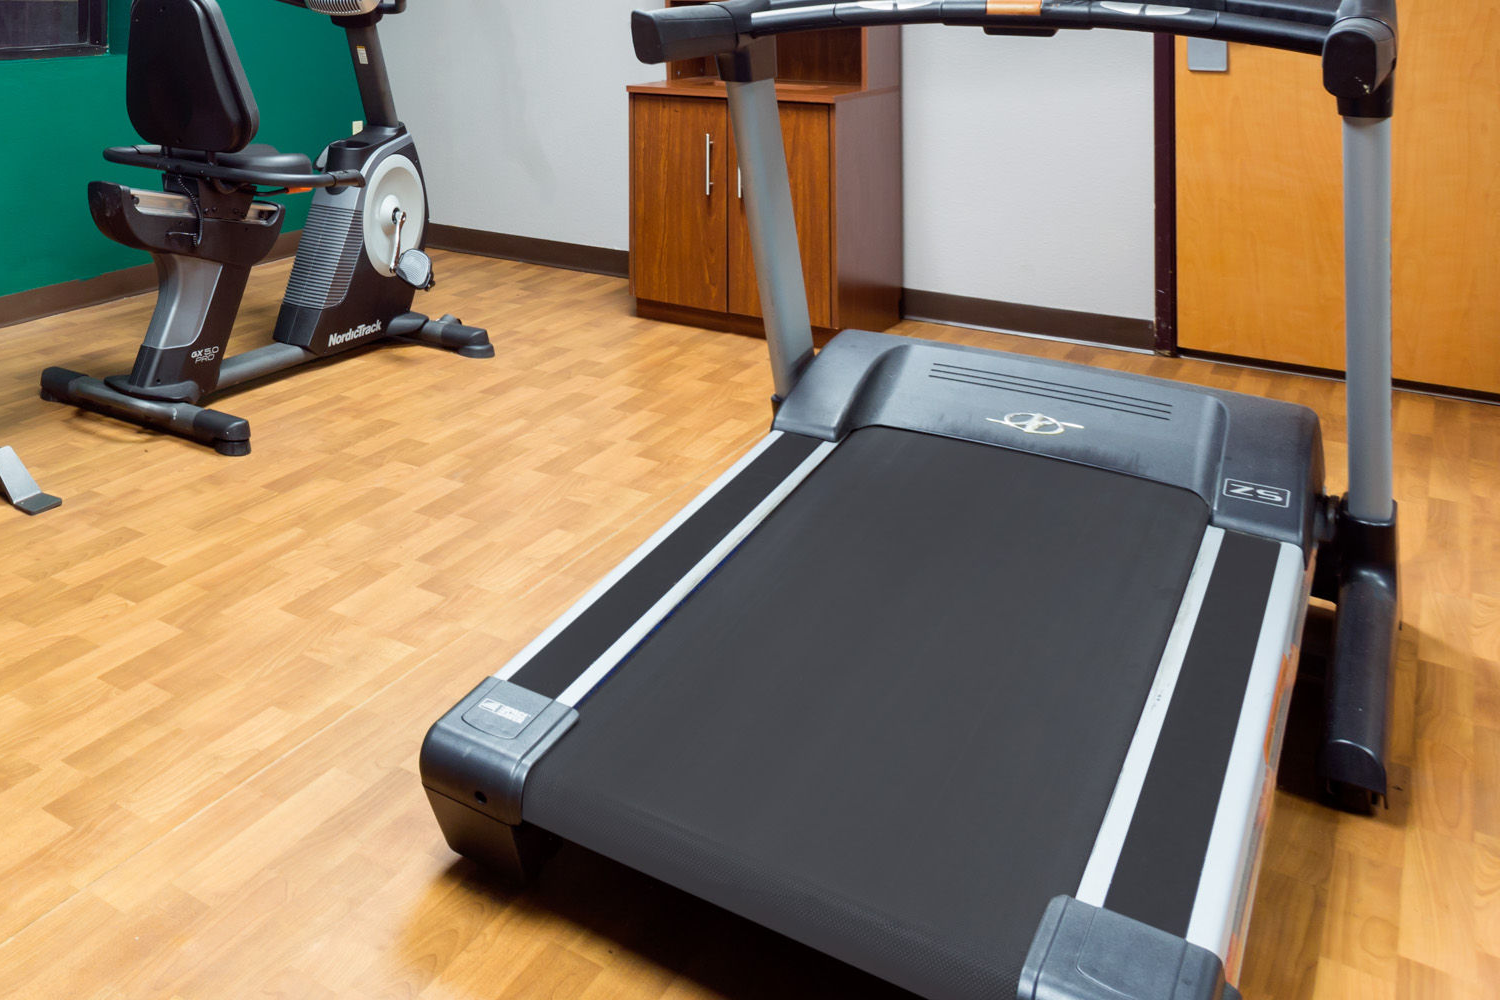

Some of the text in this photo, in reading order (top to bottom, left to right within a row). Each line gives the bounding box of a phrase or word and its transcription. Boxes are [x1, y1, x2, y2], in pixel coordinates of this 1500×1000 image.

[328, 319, 382, 348] NordicTrack
[191, 350, 204, 359] GX
[194, 353, 215, 365] PRO
